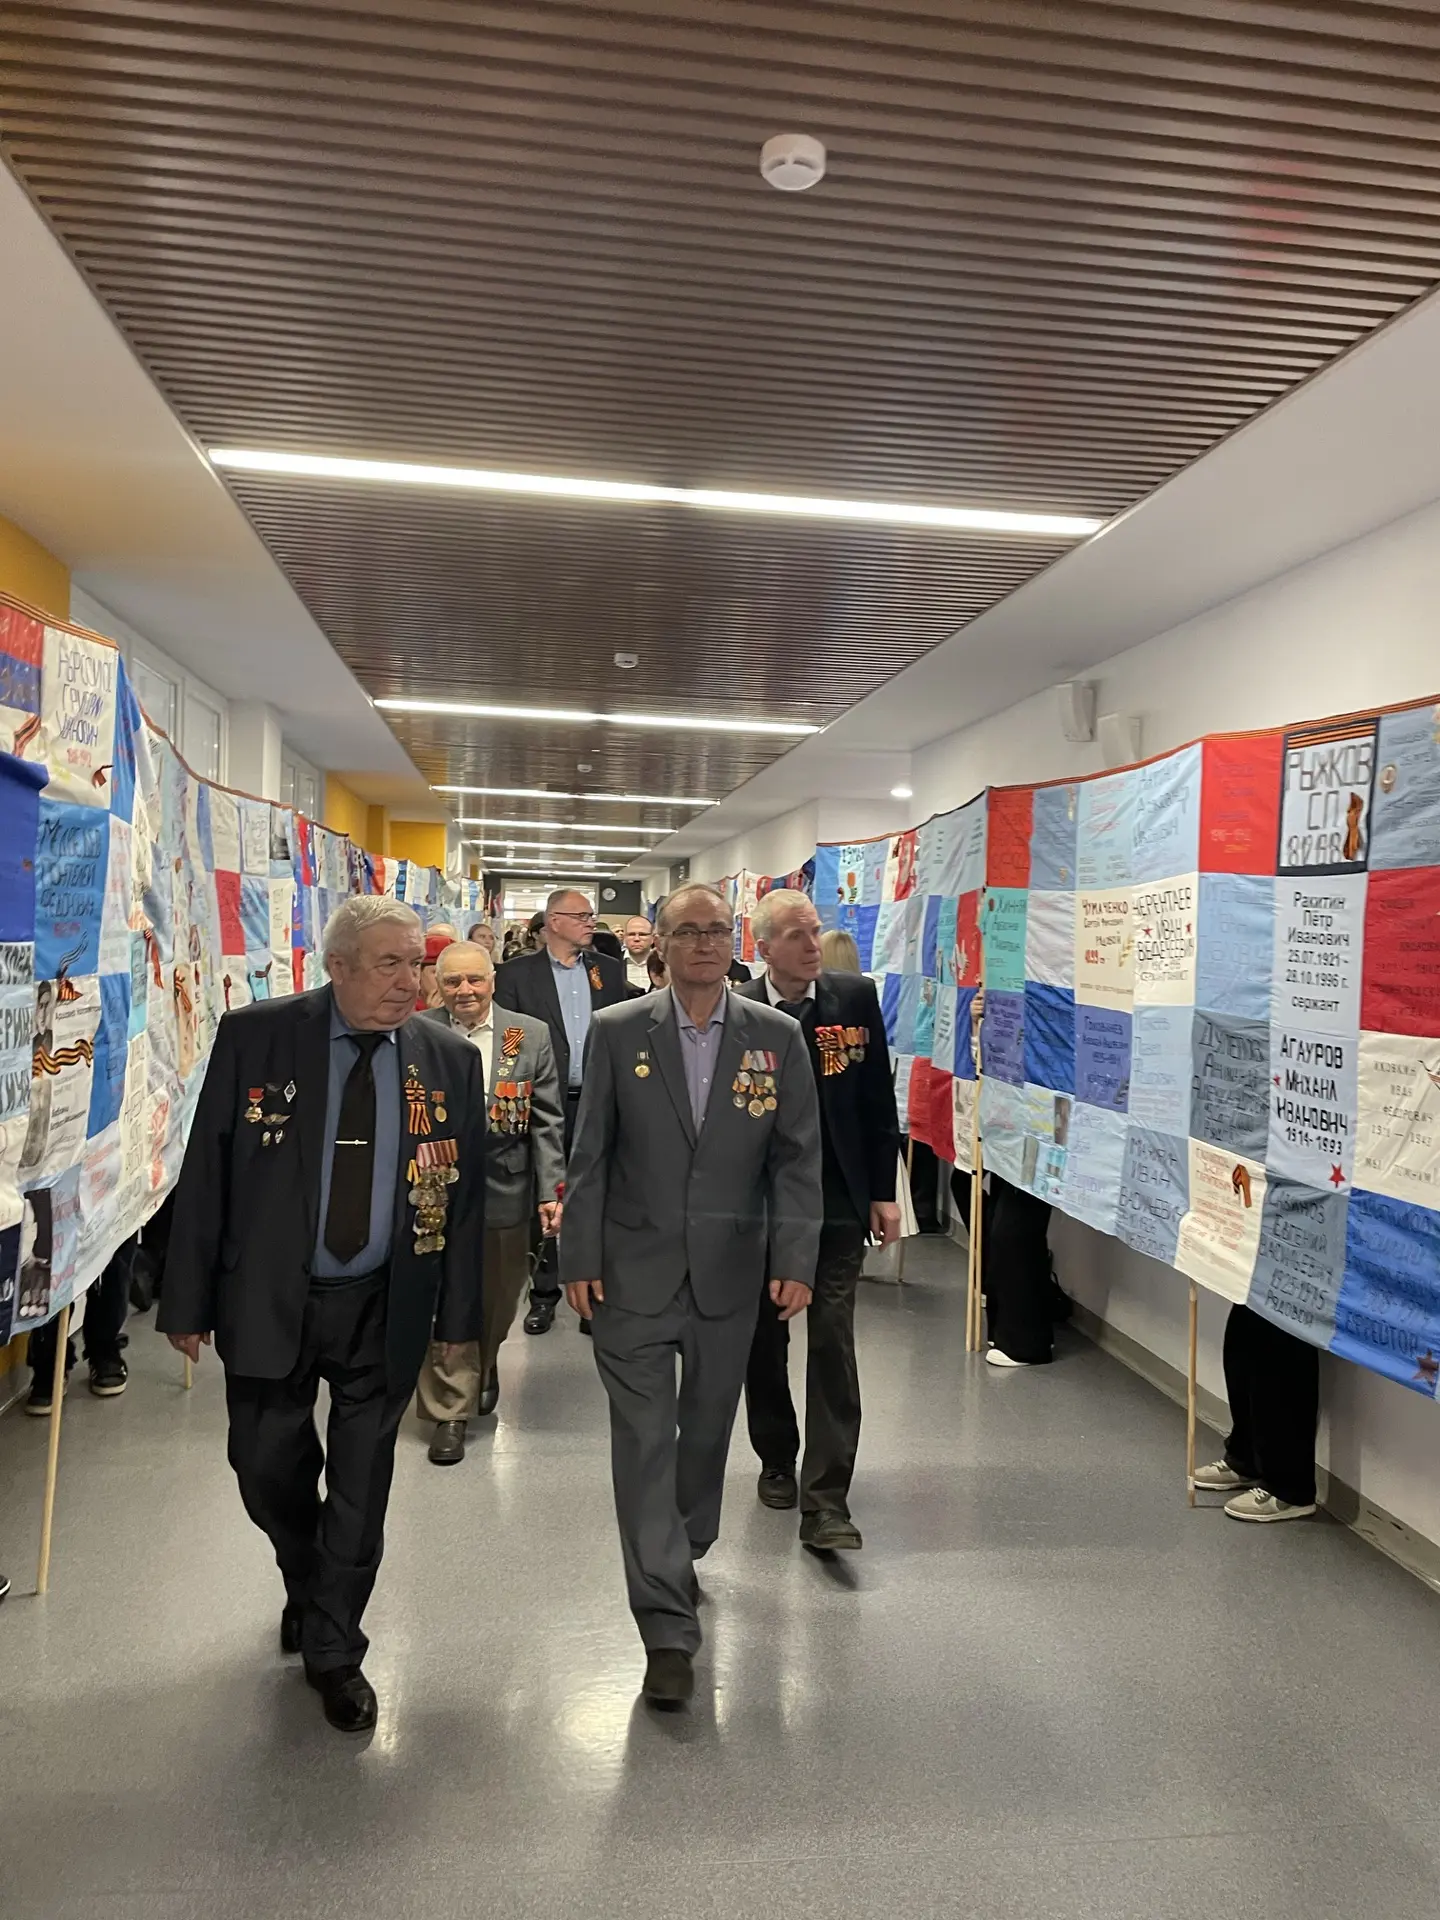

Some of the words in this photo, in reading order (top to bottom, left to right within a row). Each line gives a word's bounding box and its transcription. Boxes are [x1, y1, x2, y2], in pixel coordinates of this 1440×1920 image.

[1293, 891, 1346, 910] Ракитин
[1287, 926, 1350, 947] Иванович
[1291, 995, 1340, 1013] сержант
[1280, 1034, 1343, 1069] АГАУРОВ
[1276, 1096, 1349, 1136] ИВАНОВИЧ
